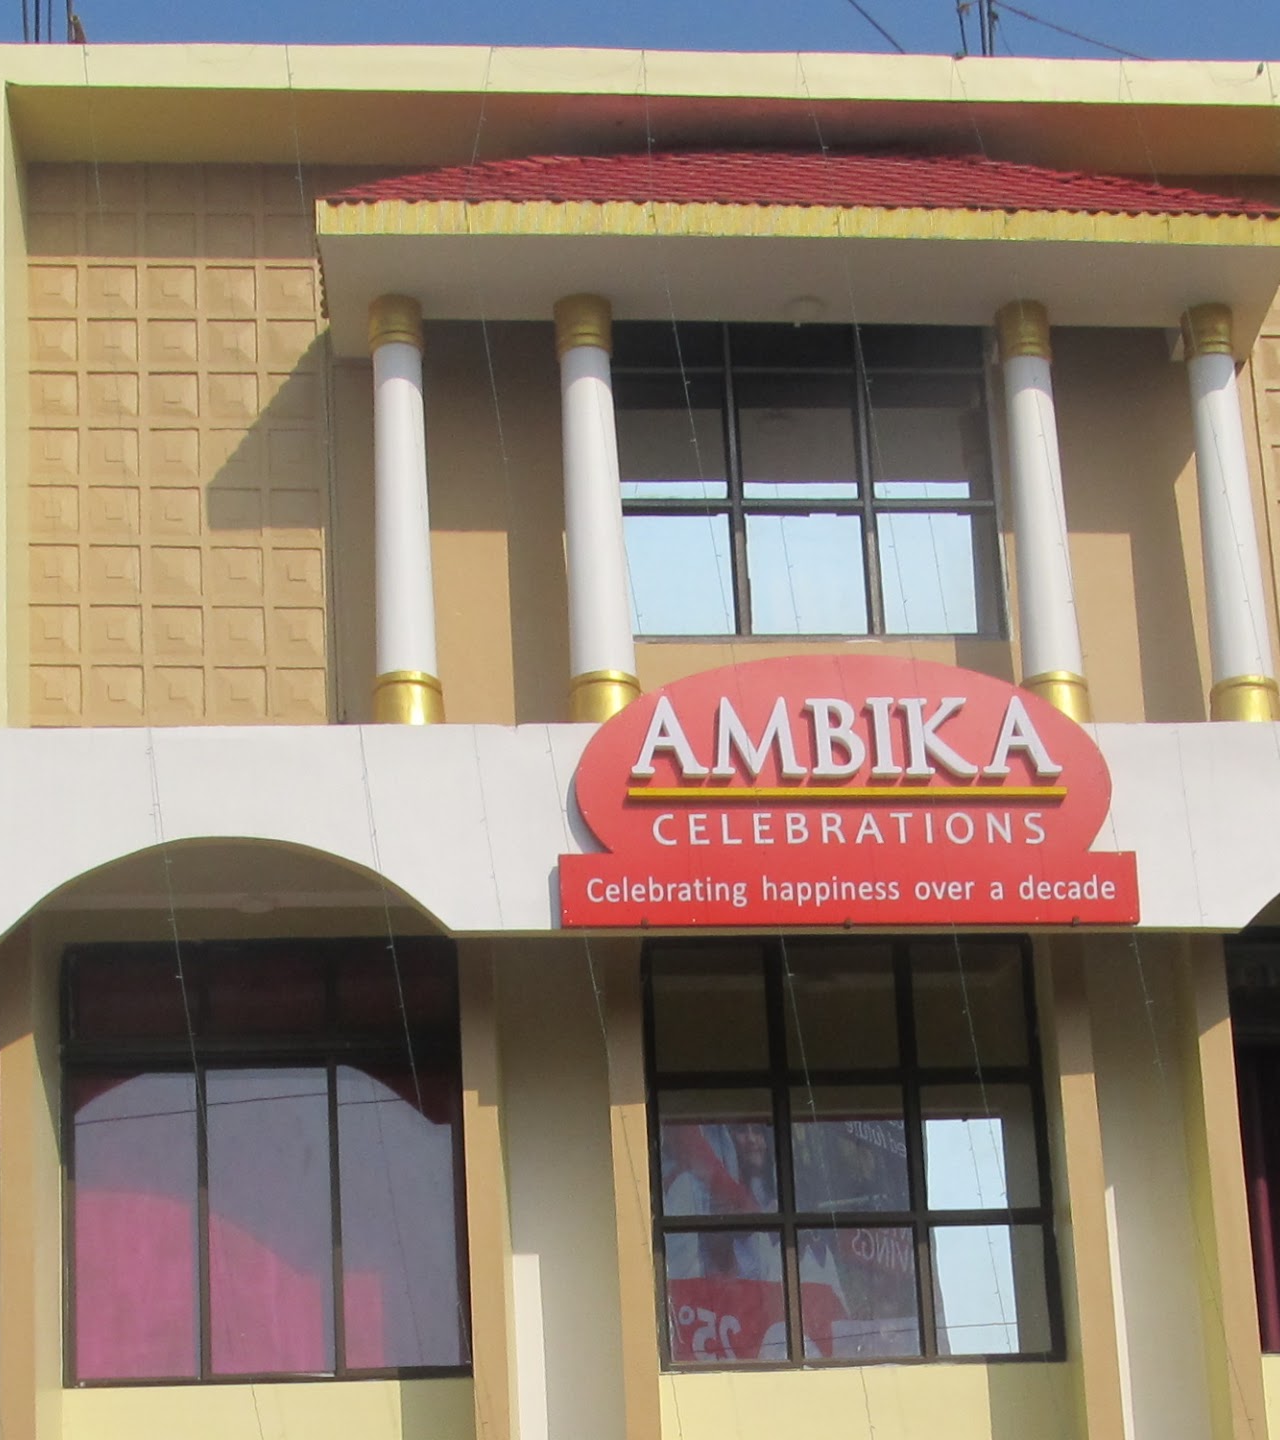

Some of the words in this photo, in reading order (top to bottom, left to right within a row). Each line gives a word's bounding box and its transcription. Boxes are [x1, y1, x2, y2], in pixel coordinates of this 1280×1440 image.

[631, 695, 1064, 780] AMBIKA
[652, 812, 1047, 846] CELEBRATIONS
[586, 876, 748, 907] Celebrating
[761, 875, 901, 903] happiness
[914, 880, 975, 901] over
[990, 880, 1005, 900] a
[1019, 874, 1117, 901] decade
